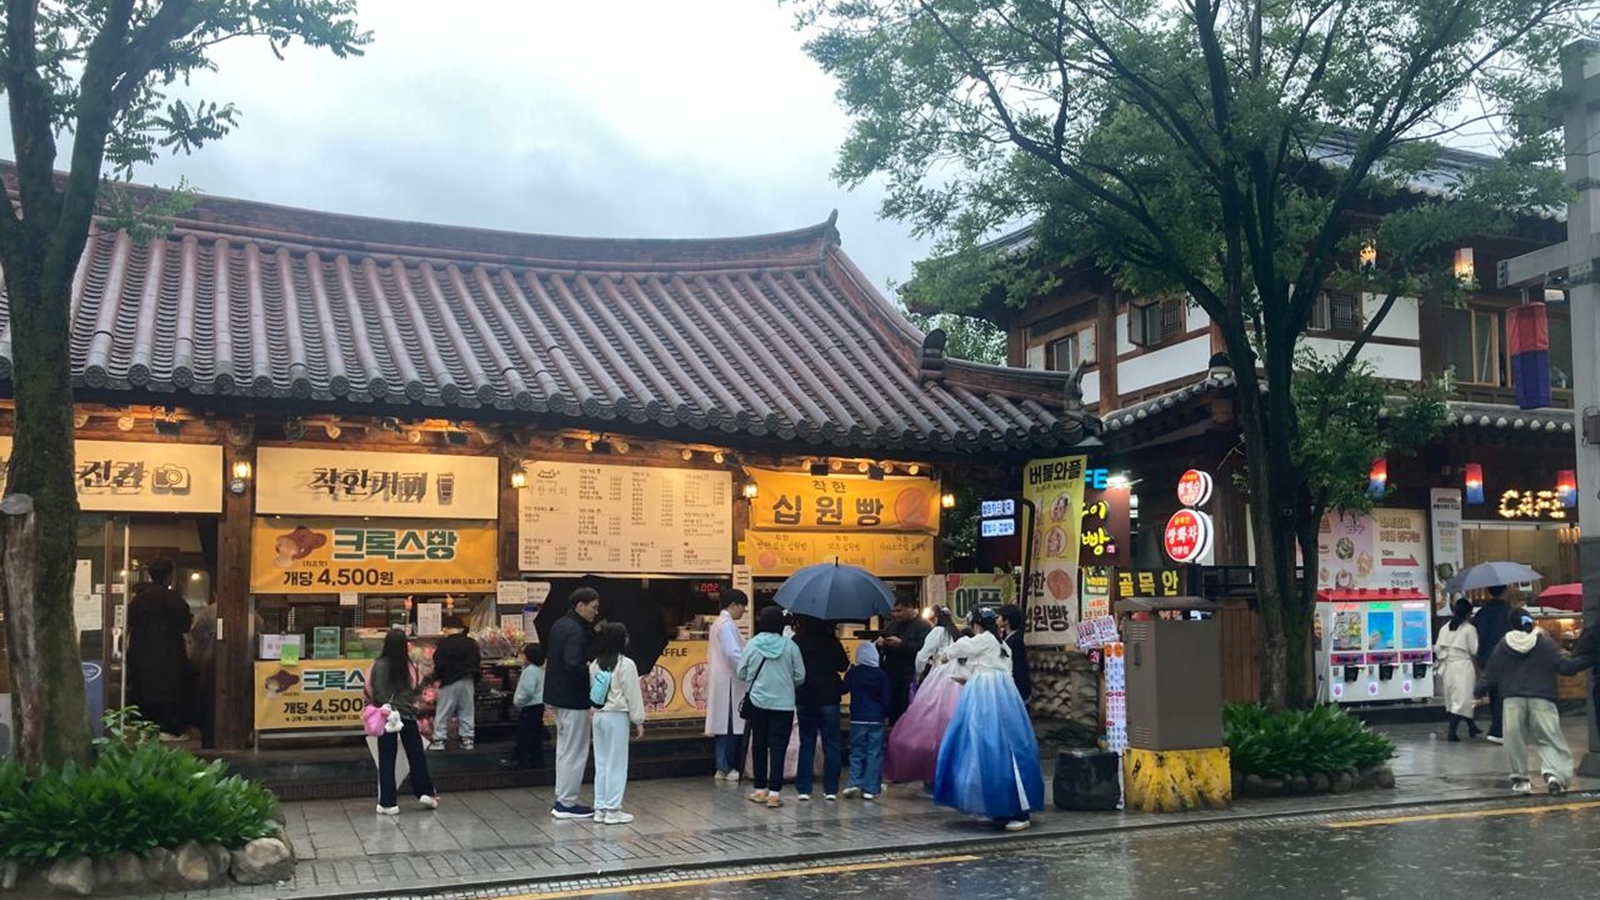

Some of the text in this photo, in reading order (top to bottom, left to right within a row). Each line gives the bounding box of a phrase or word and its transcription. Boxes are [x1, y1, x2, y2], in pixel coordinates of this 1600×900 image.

[1030, 459, 1083, 485] 버블와플
[812, 479, 854, 493] 착한
[773, 494, 885, 526] 십원빵
[1499, 489, 1566, 518] CAFE
[333, 528, 457, 560] 크록스빵
[284, 569, 393, 586] 개당 4,500원
[662, 647, 688, 657] FFLE
[284, 698, 365, 714] 개당 4,500
